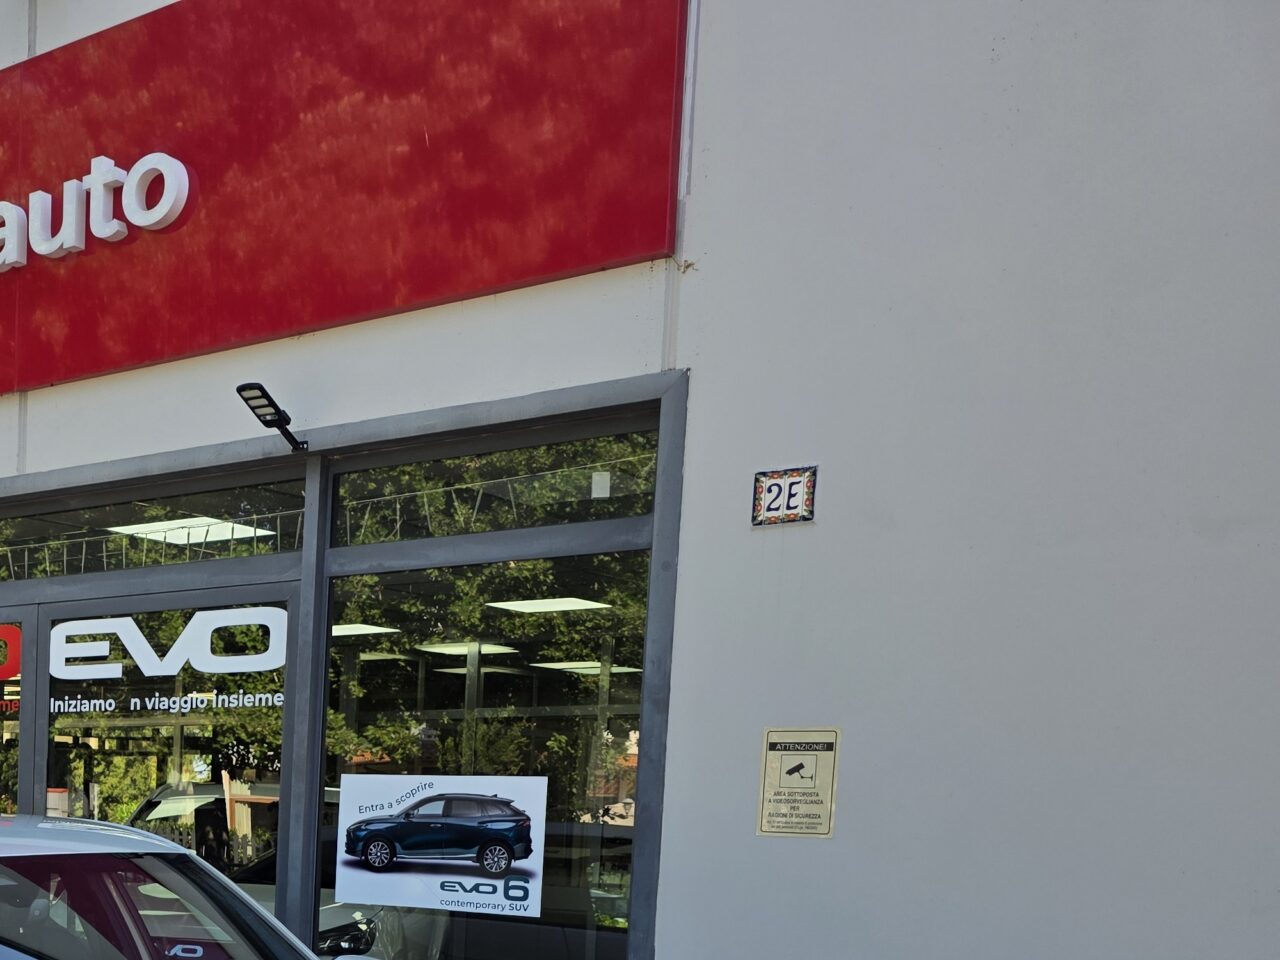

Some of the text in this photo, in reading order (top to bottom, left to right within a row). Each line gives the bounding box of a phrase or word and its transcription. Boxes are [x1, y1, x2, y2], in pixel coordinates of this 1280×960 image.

[766, 480, 802, 512] 2E
[49, 606, 288, 680] EVO
[50, 694, 116, 713] Iniziamo
[144, 691, 208, 713] viaggio
[212, 689, 285, 708] insieme
[358, 780, 434, 814] Entra a scoprire
[439, 875, 530, 902] EVO 6
[439, 898, 530, 912] contemporary SUV
